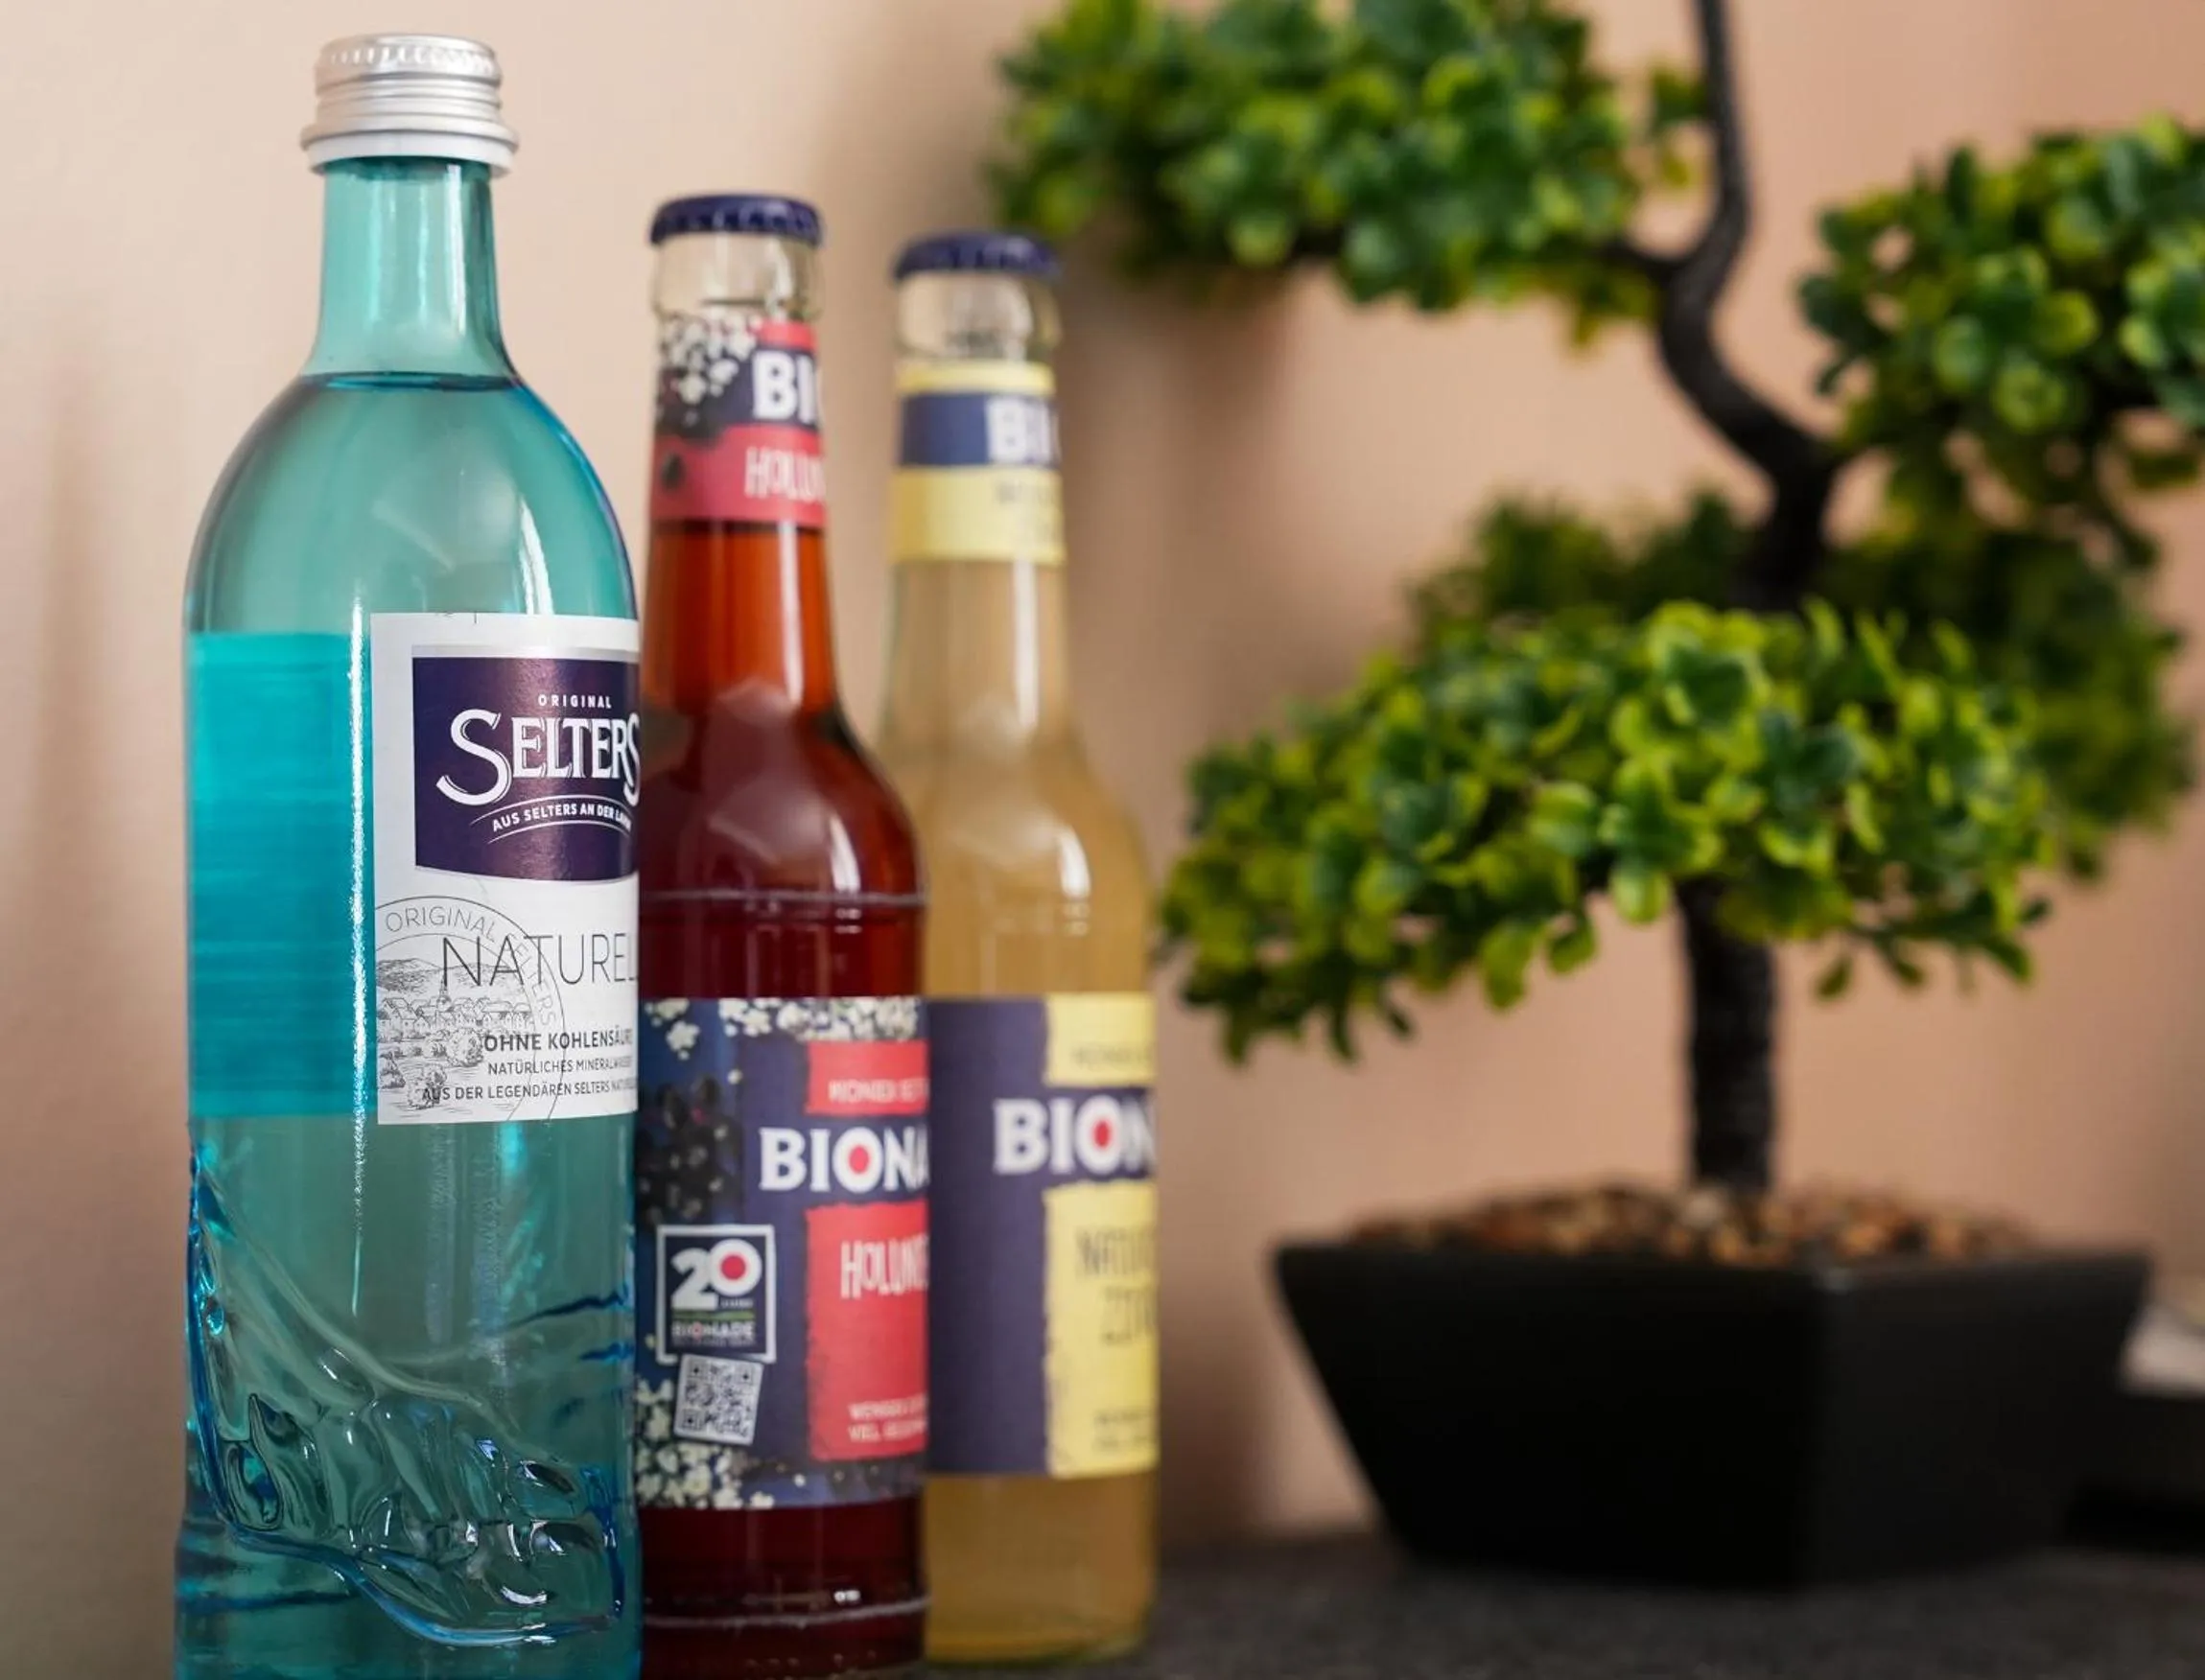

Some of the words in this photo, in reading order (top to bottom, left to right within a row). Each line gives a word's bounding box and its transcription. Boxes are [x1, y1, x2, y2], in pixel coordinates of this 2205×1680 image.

[538, 694, 612, 709] ORIGINAL
[436, 709, 641, 806] SELTERS
[492, 812, 521, 832] AUS
[524, 804, 577, 822] SELTERS
[579, 804, 596, 816] AN
[597, 805, 617, 819] DER
[386, 905, 496, 943] ORIGINAL
[501, 932, 556, 1026] SELTERS
[484, 1033, 541, 1052] OHNE
[488, 1059, 574, 1075] NATÜRLICHES
[421, 1086, 451, 1101] AUS
[455, 1086, 483, 1100] DER
[488, 1081, 572, 1100] LEGENDÄREN
[575, 1081, 610, 1094] SELTERS
[671, 1239, 762, 1310] 20
